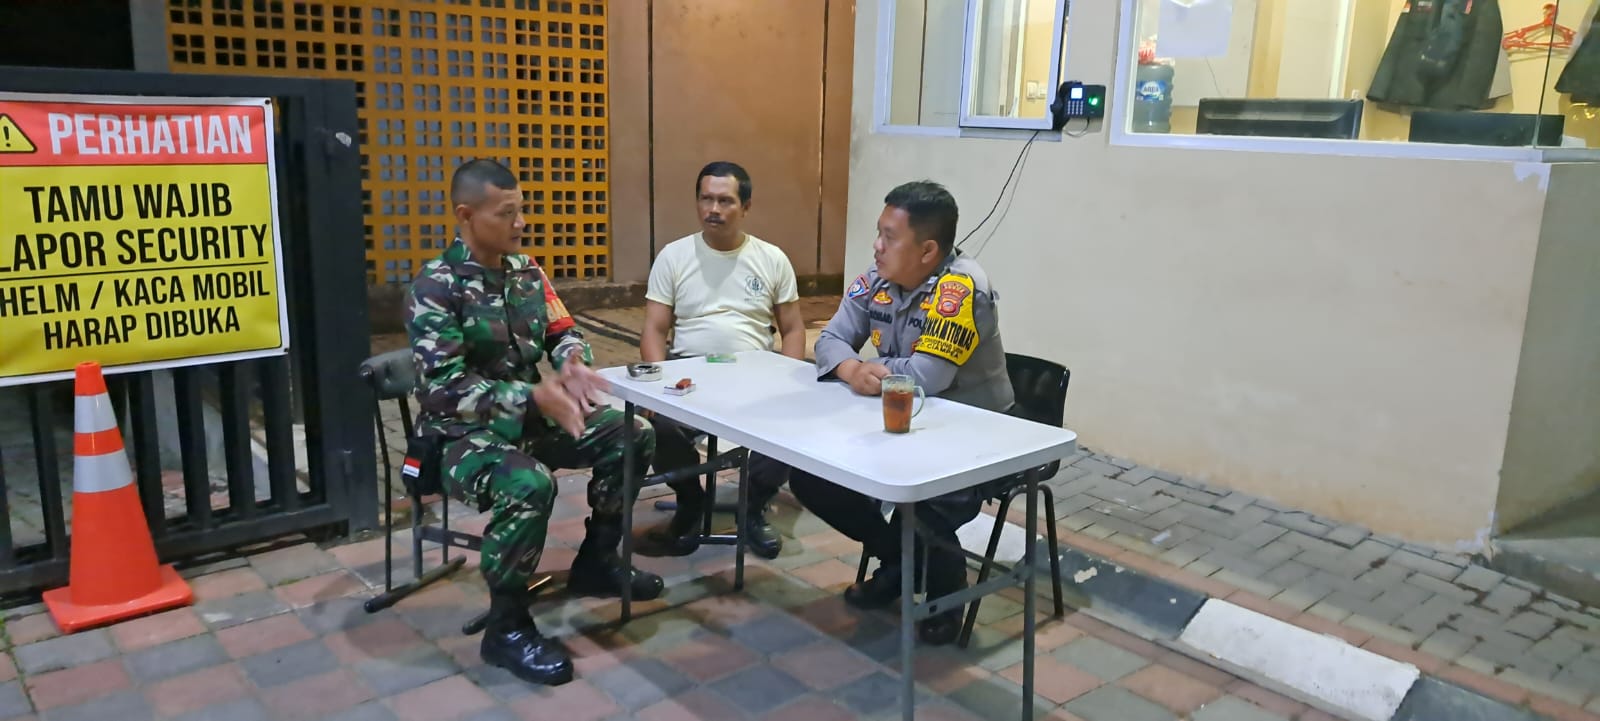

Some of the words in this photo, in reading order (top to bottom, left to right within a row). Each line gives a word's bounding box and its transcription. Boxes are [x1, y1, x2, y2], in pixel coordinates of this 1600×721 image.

[48, 113, 252, 154] PERHATIAN
[24, 185, 124, 223] TAMU
[133, 183, 232, 219] WAJIB
[116, 224, 268, 264] SECURITY
[0, 283, 80, 317] HELM
[91, 281, 104, 309] /
[114, 276, 185, 307] KACA
[193, 270, 270, 301] MOBIL
[44, 315, 136, 350] HARAP
[146, 306, 240, 341] DIBUKA
